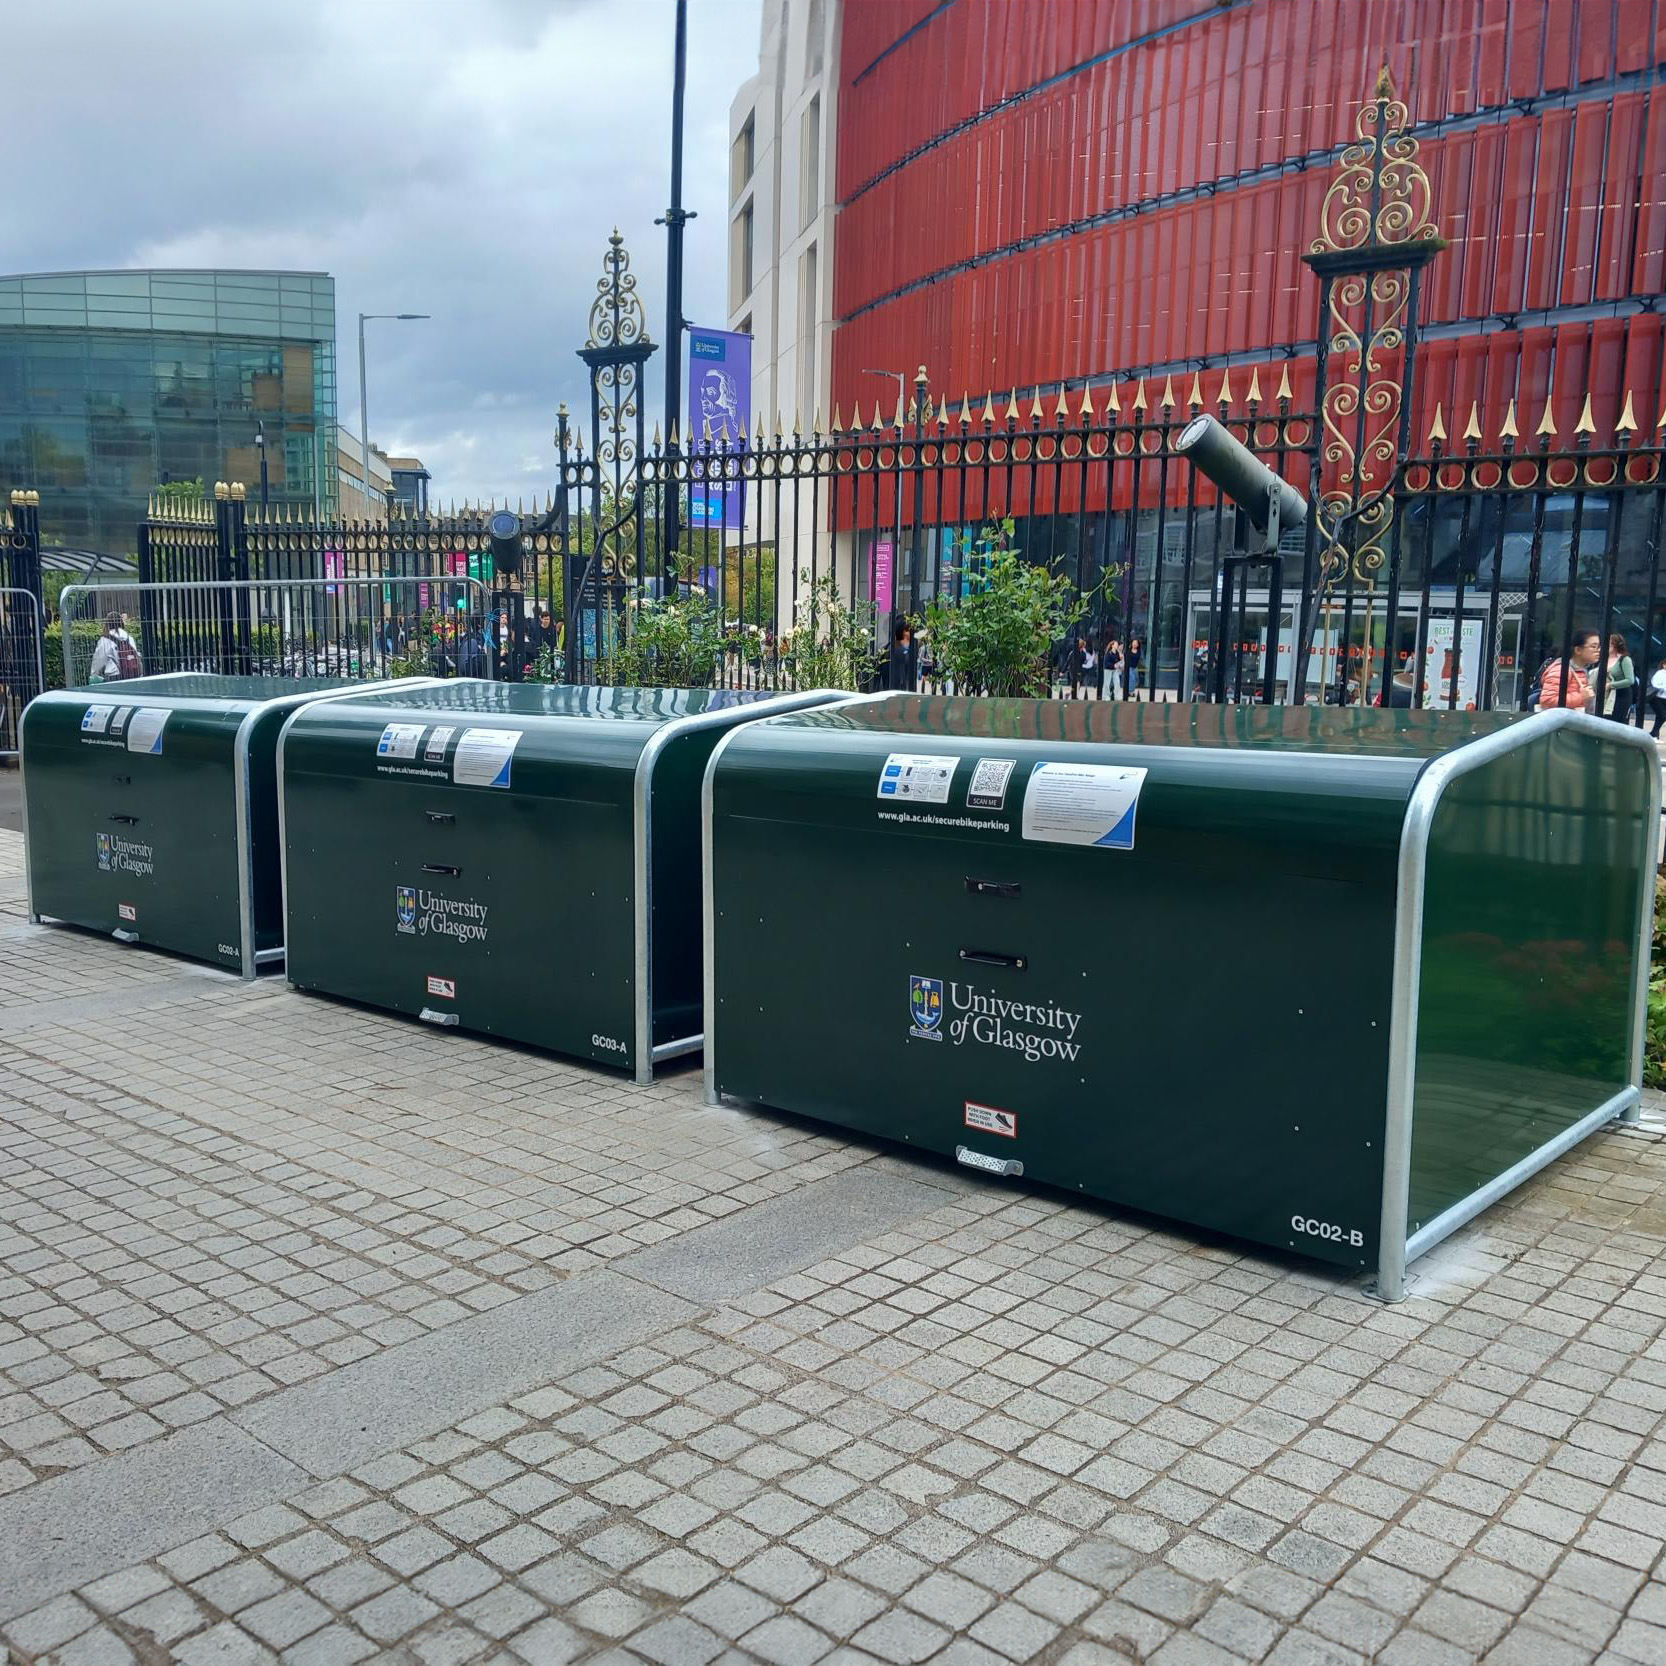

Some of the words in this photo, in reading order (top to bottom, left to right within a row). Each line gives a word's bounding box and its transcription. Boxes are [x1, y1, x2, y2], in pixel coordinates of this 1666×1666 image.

[1434, 626, 1450, 635] BEST
[972, 797, 989, 806] SCAN
[877, 811, 1010, 832] www.gla.ac.uk/securebikeparking
[110, 834, 153, 862] University
[111, 851, 120, 872] of
[118, 852, 154, 877] Glasgow
[418, 889, 488, 926] University
[418, 910, 432, 936] of
[430, 912, 488, 943] Glasgow
[950, 981, 1082, 1040] University
[592, 1034, 628, 1054] GC03-A
[950, 1012, 974, 1046] of
[972, 1015, 1081, 1062] Glasgow
[1291, 1215, 1364, 1247] GC02-B
